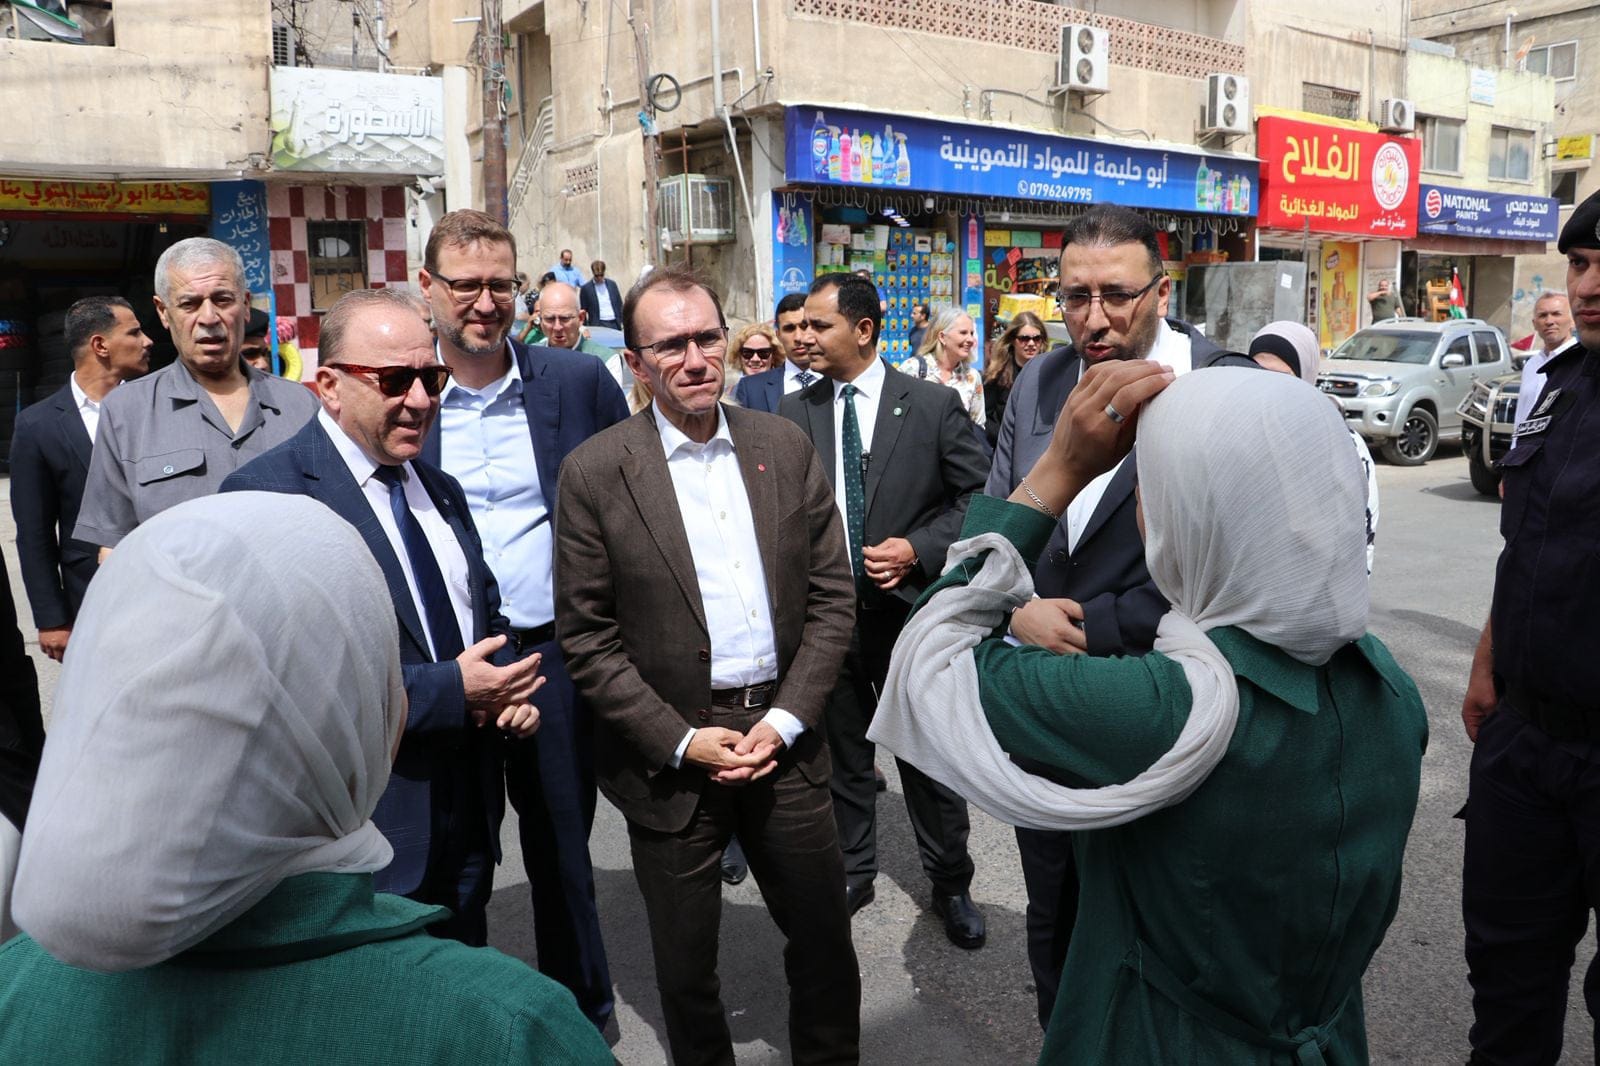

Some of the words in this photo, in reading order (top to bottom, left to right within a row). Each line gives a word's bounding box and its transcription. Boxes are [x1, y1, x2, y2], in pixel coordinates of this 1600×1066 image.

[326, 97, 432, 145] الأسطورة
[940, 135, 1028, 172] التموينية
[1033, 148, 1089, 179] للمواد
[1282, 134, 1360, 183] الفلاح
[1094, 154, 1142, 186] حليمة
[1146, 153, 1169, 189] أبو
[127, 184, 149, 206] ابو
[151, 182, 207, 201] محطة
[1029, 184, 1093, 201] 0796249795
[1280, 193, 1325, 218] الغذائية
[1325, 202, 1359, 222] للمواد
[1443, 194, 1491, 212] NATIONAL
[1505, 200, 1528, 218] صبحي
[1529, 201, 1548, 215] محمد
[1455, 209, 1479, 221] PAINTS
[226, 220, 259, 240] غيار
